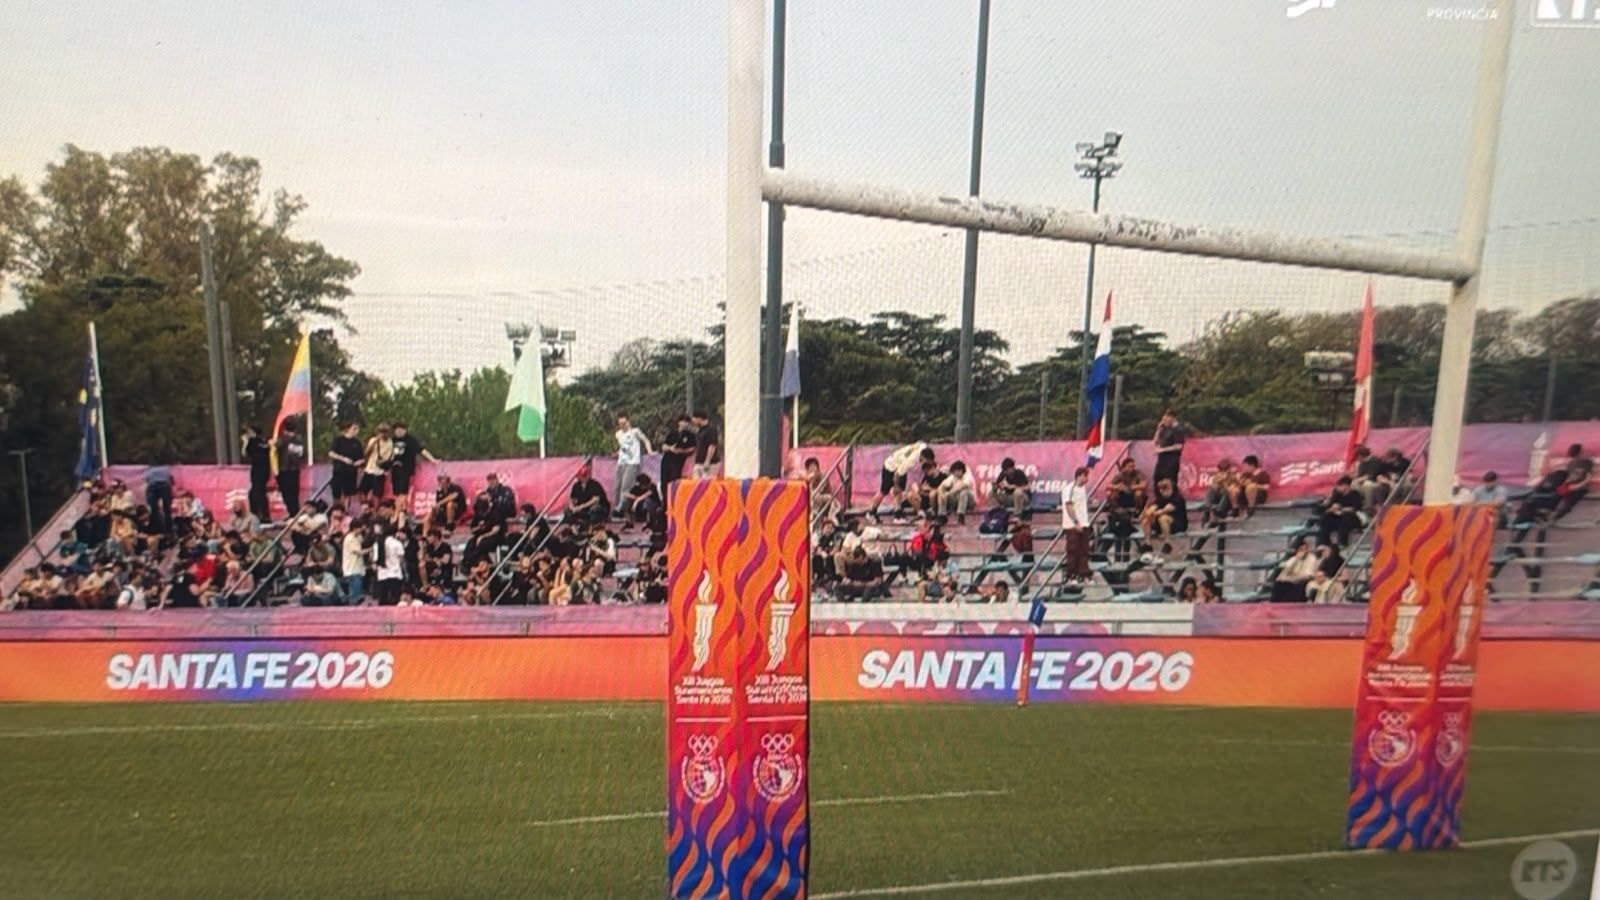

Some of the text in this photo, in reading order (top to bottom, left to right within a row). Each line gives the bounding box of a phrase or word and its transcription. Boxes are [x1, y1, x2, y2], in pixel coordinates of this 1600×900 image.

[106, 651, 394, 690] SANTA FE 2026
[858, 650, 1006, 690] SANTA
[1069, 651, 1194, 691] 2026
[676, 694, 698, 705] Santa
[700, 695, 711, 705] Fe
[747, 694, 774, 705] Santa
[775, 694, 787, 705] Fe
